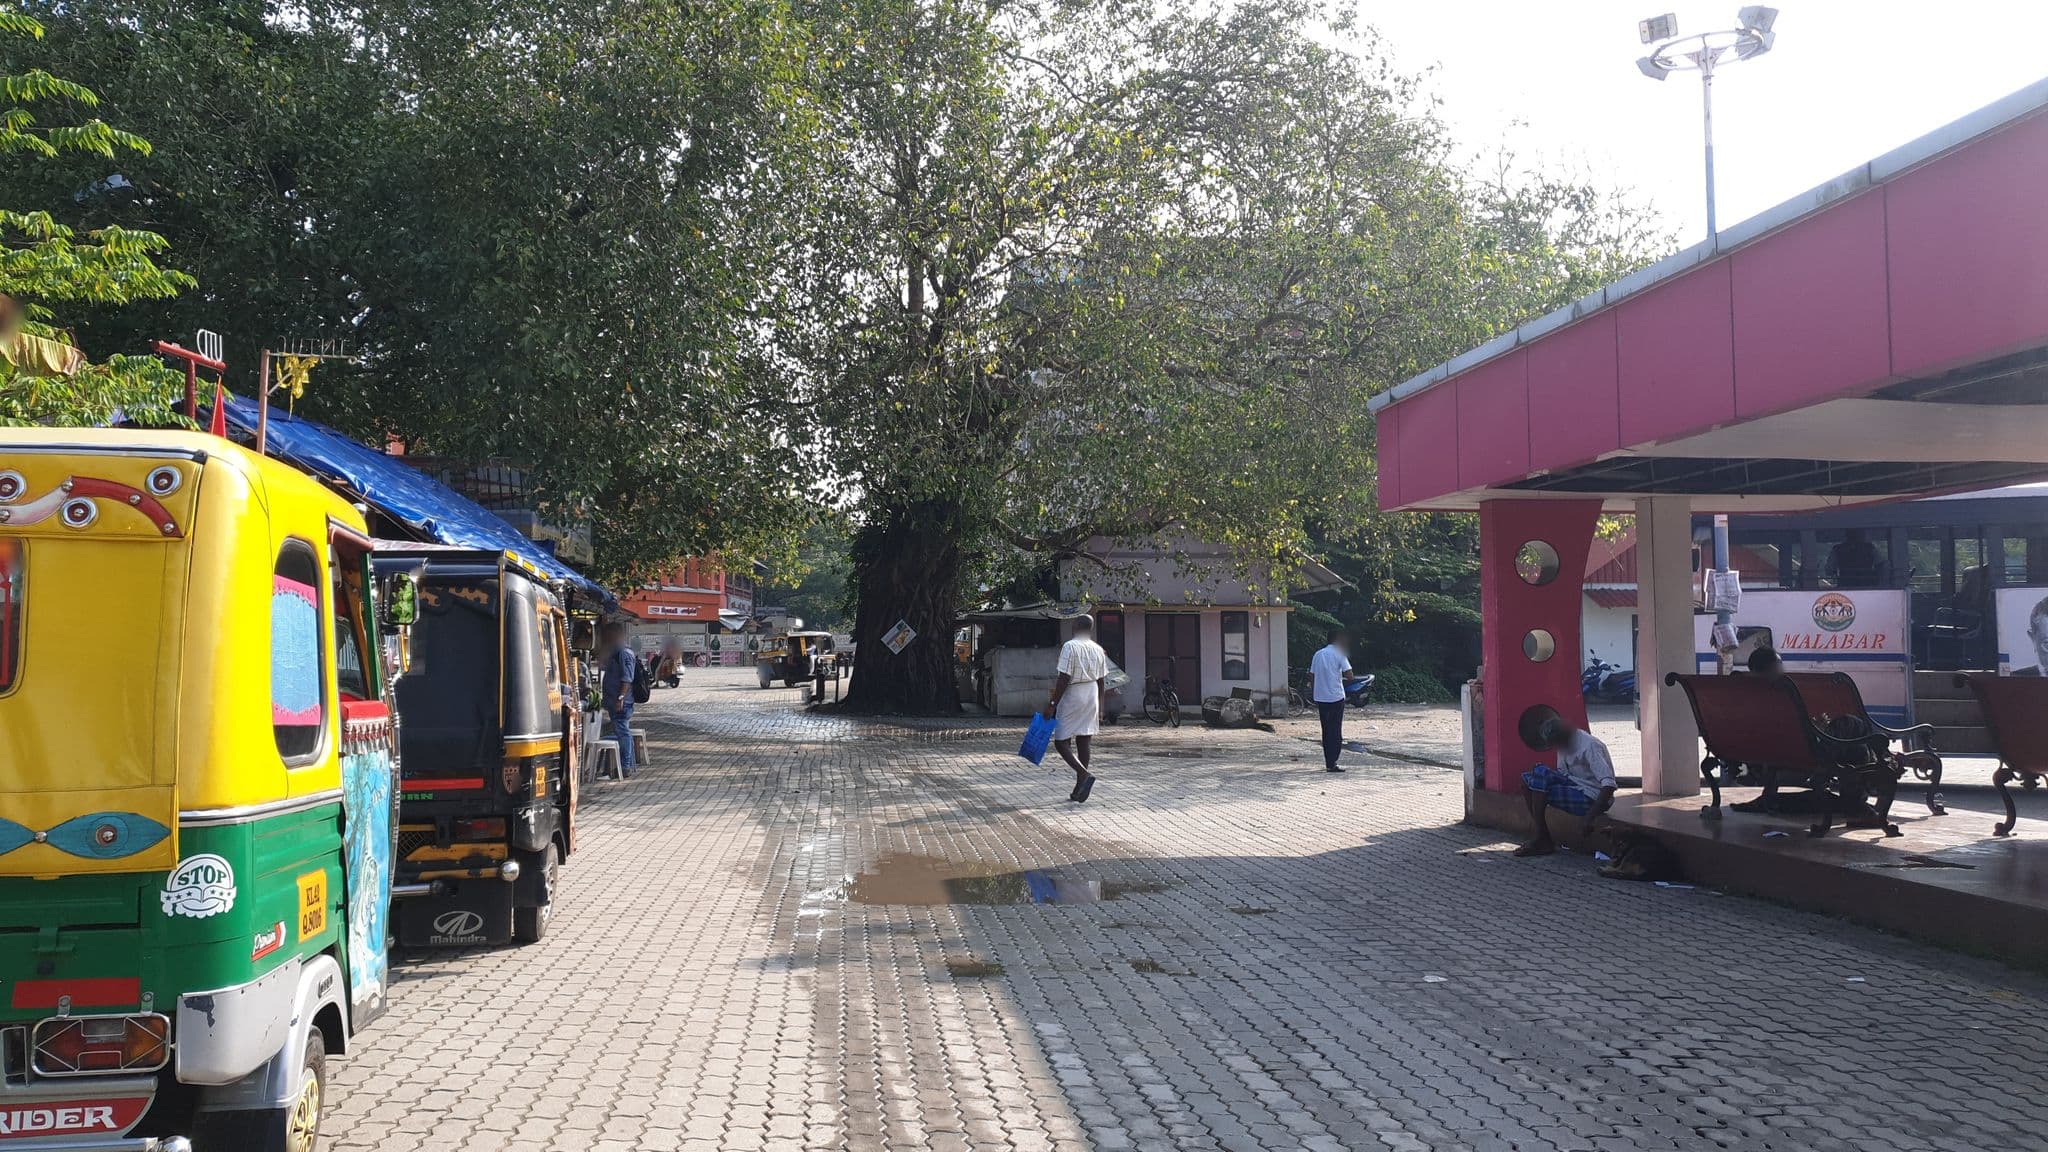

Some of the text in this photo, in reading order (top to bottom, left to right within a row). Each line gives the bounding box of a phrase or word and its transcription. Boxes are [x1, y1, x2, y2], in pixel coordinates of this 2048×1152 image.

[1781, 633, 1886, 650] MALABAR
[177, 864, 227, 886] STOP
[430, 934, 487, 945] Mahindra
